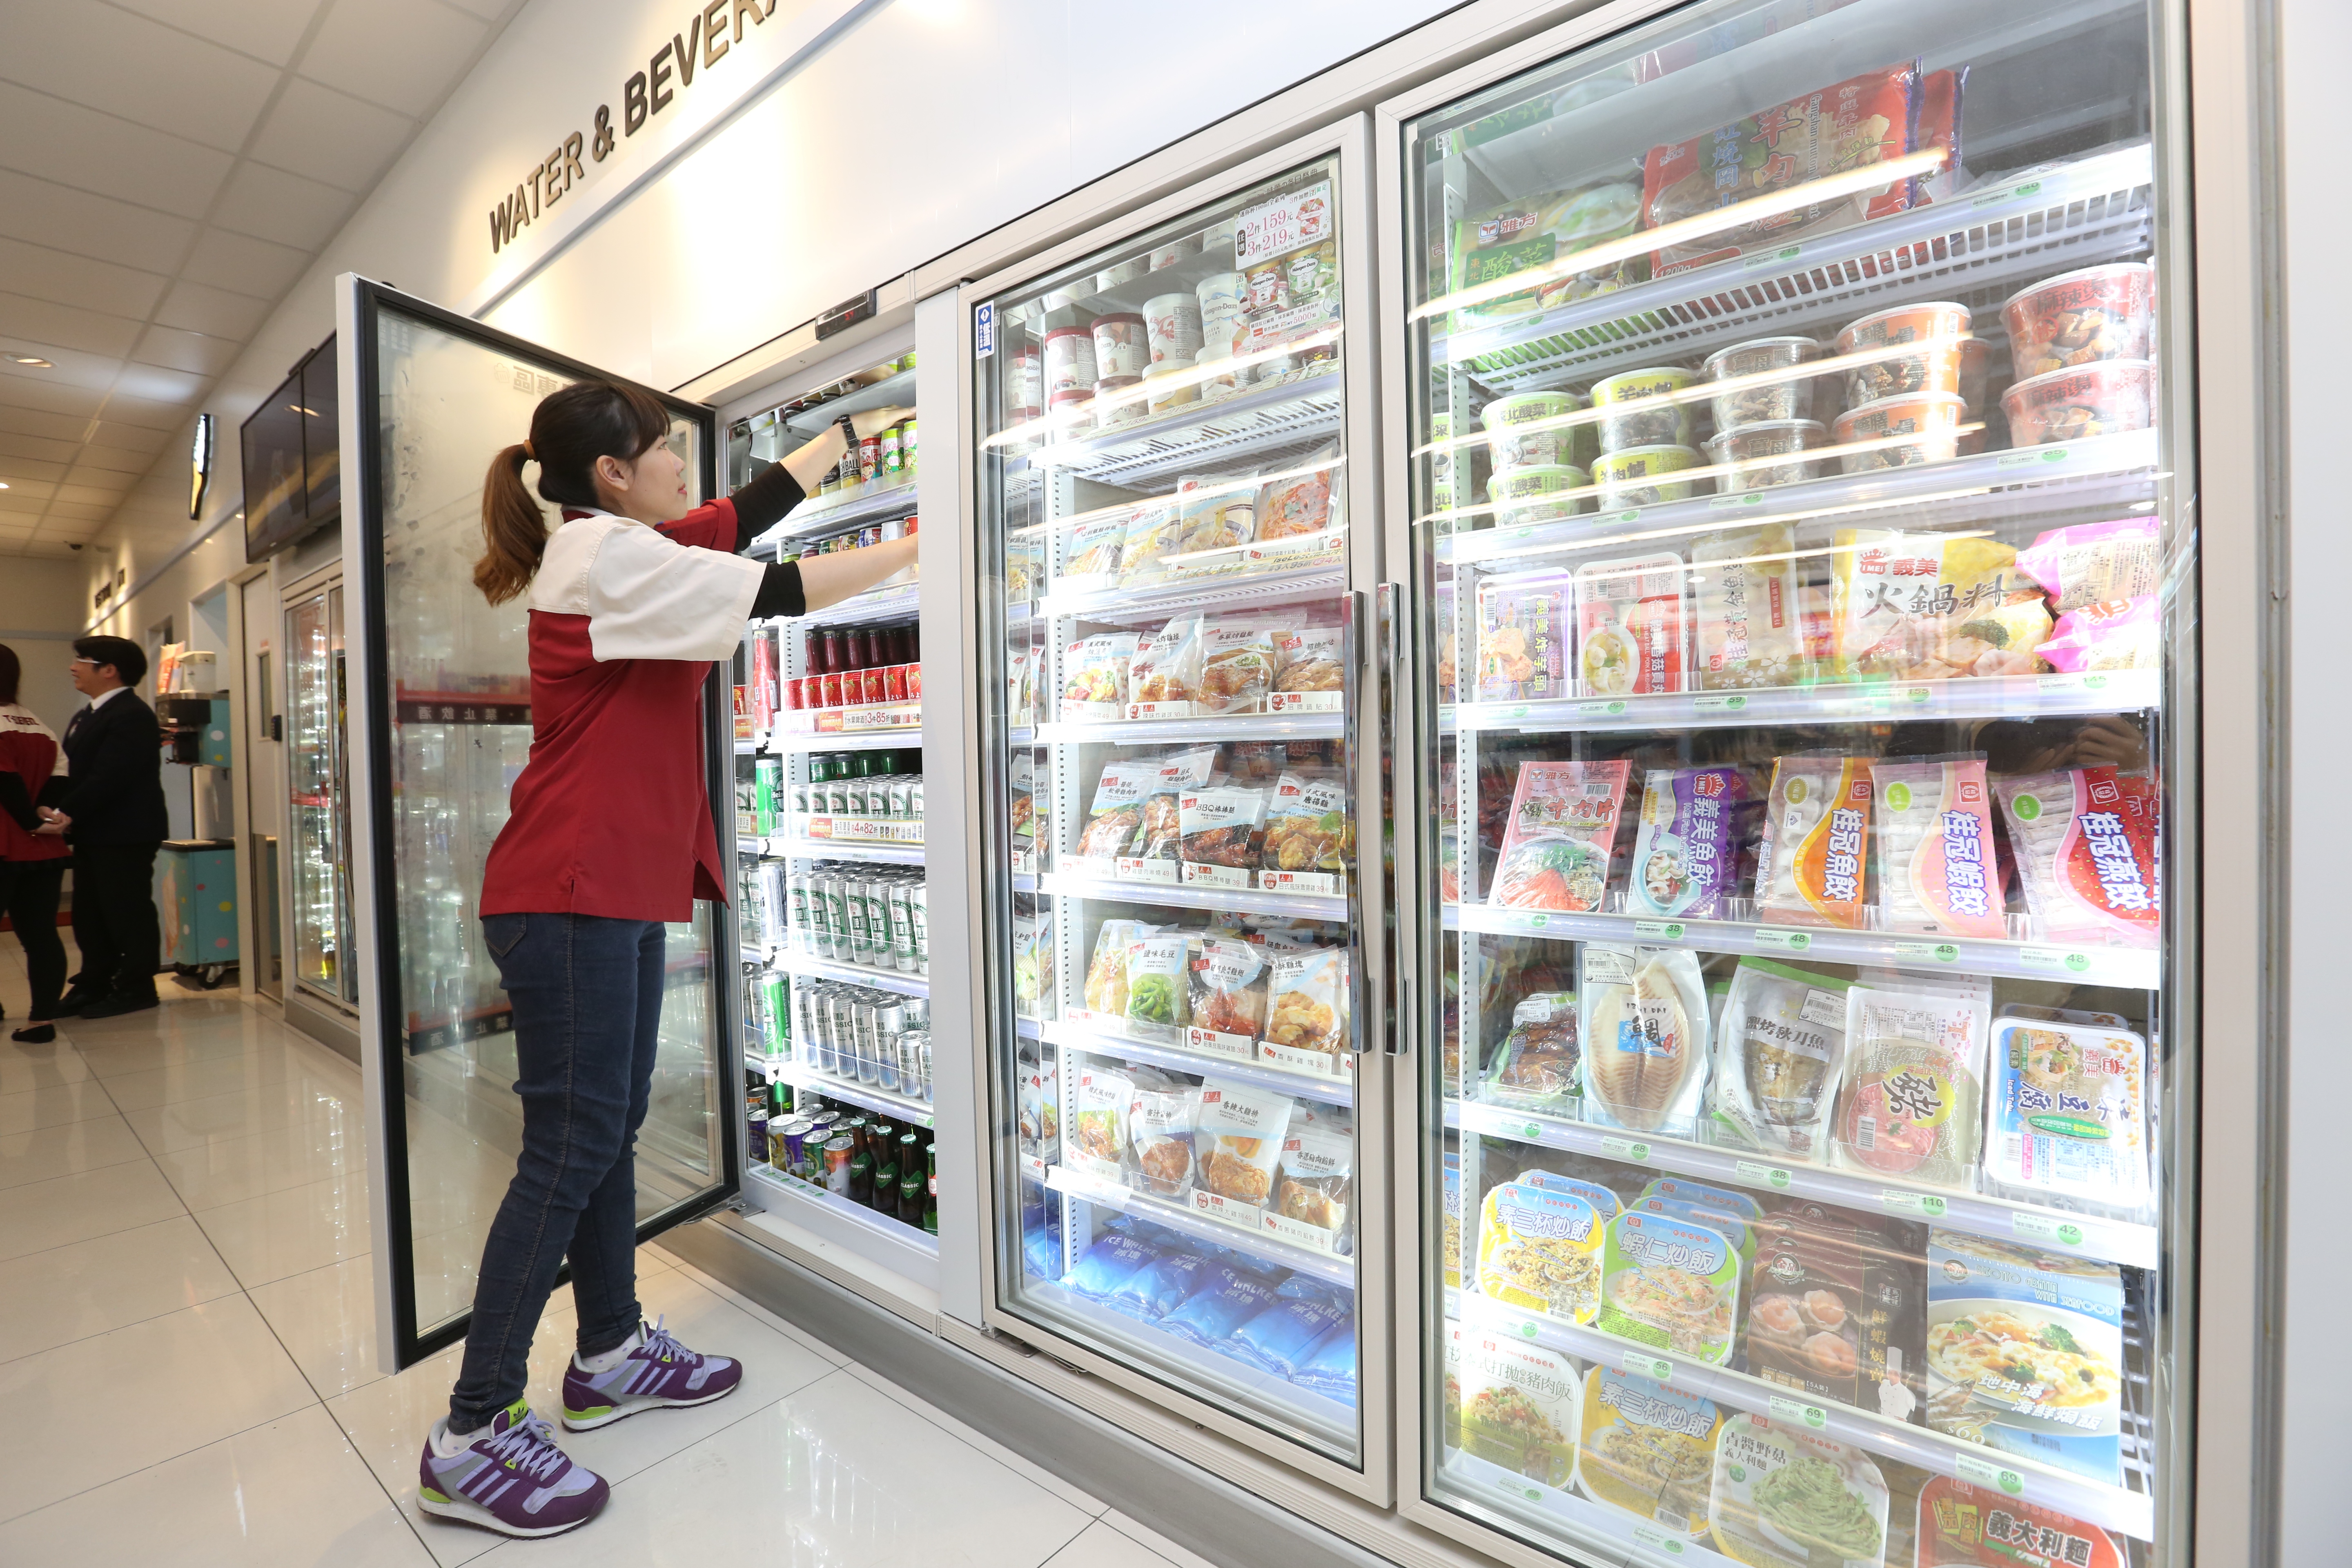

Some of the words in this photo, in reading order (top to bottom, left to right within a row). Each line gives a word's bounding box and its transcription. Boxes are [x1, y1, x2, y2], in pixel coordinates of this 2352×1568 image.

[1809, 94, 1822, 136] Gangshan
[1808, 138, 1821, 173] mutton
[490, 130, 584, 254] WATER
[592, 104, 615, 162] &
[1247, 209, 1293, 238] 2件159元
[1500, 213, 1538, 234] 雅方
[1247, 229, 1294, 256] 3件219元
[1292, 261, 1316, 272] Häagen-Dazs
[1252, 276, 1274, 286] Häagen-Dazs
[1892, 557, 1938, 578] 義美
[1860, 573, 2011, 619] 火鍋料
[1534, 598, 1550, 693] 義美炸芋頭
[846, 716, 865, 724] 水果啤酒
[1544, 770, 1571, 781] 雅方
[1196, 803, 1236, 814] BBQ棒棒腿
[1303, 796, 1330, 808] 唐揚雞
[1545, 797, 1617, 822] 牛肉片
[854, 822, 878, 834] 4件82折
[1686, 797, 1720, 886] 義美魚餃
[1822, 807, 1864, 902] 桂冠魚餃
[1940, 809, 1990, 917] 桂冠蝦餃
[2077, 811, 2153, 911] 桂冠燕餃
[1198, 874, 1231, 885] BBQ棒棒腿
[1278, 883, 1316, 892] 日式風味唐揚雞
[1791, 934, 1806, 943] 48
[1143, 949, 1175, 959] 鹽味毛豆
[1937, 945, 1954, 954] 48
[2067, 954, 2085, 963] 48
[1745, 1015, 1825, 1051] 鹽烤秋刀魚
[1277, 1053, 1314, 1067] 香酥雞塊
[2083, 1048, 2102, 1078] 義美
[1222, 1100, 1259, 1118] 香辣大雞排
[1527, 1123, 1539, 1131] 55
[1634, 1144, 1646, 1153] 68
[1773, 1169, 1786, 1179] 38
[1211, 1204, 1244, 1219] 香辣大雞排
[1922, 1197, 1943, 1208] 110
[1496, 1203, 1594, 1245] 素三杯炒飯
[2059, 1227, 2077, 1236] 42
[1103, 1235, 1120, 1245] ICE
[1619, 1232, 1714, 1275] 蝦仁炒飯
[1976, 1265, 2021, 1285] RISOTTO
[2024, 1276, 2058, 1293] GRATIN
[2035, 1289, 2058, 1305] WITH
[2060, 1294, 2115, 1317] SEAFOOD
[1656, 1361, 1668, 1371] 56
[1978, 1375, 2045, 1400] 地中海
[1599, 1380, 1715, 1442] 素三杯炒飯
[1806, 1408, 1820, 1419] 69
[2011, 1401, 2105, 1432] 海鮮焗飯
[2000, 1471, 2017, 1483] 69
[1986, 1510, 2093, 1568] 義大利麵
